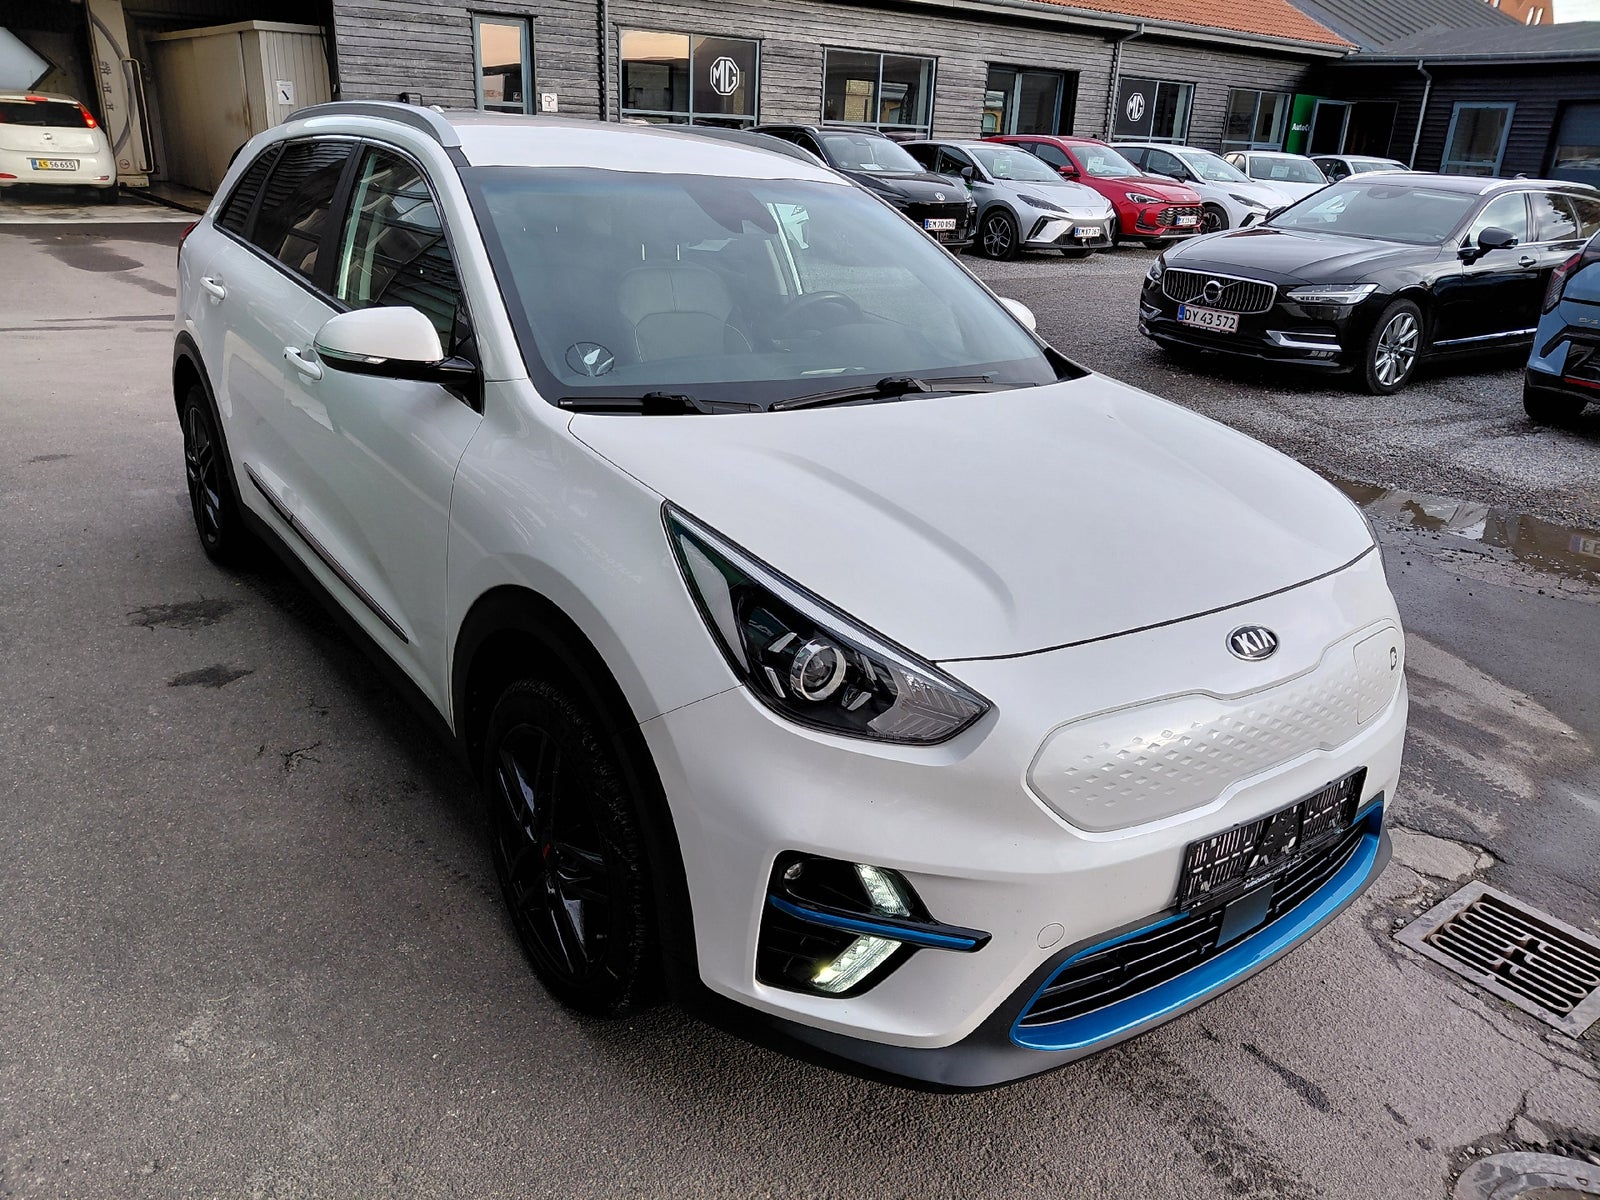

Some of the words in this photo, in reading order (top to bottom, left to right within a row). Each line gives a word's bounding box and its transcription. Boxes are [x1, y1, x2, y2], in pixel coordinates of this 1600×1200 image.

[712, 60, 737, 92] MG
[1128, 95, 1143, 119] MG
[1185, 309, 1199, 322] DY
[1200, 312, 1214, 325] 43
[1215, 315, 1236, 330] 572
[1233, 628, 1276, 655] KIA
